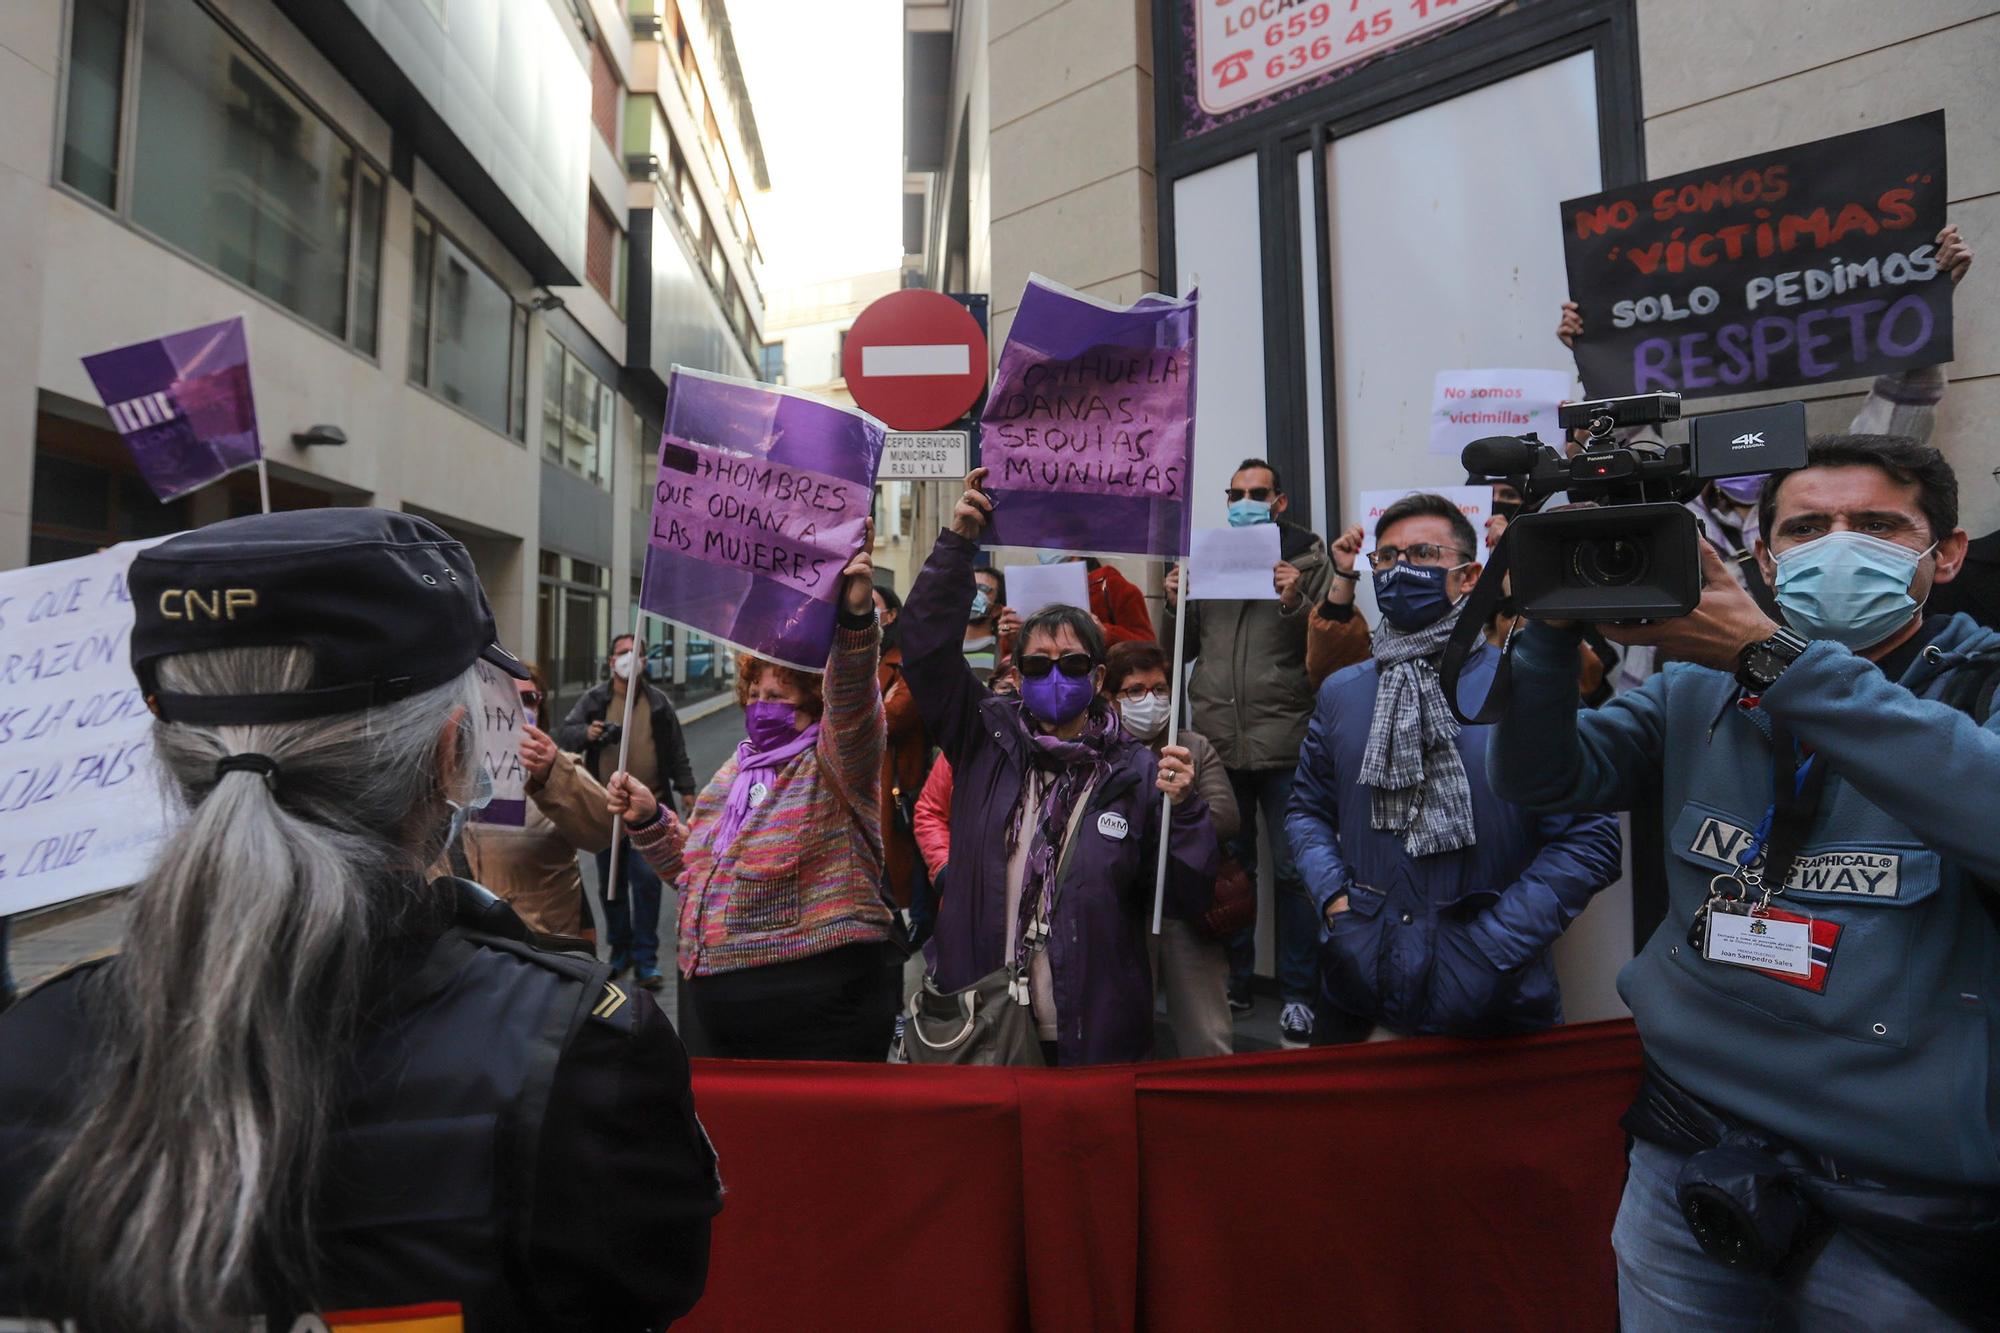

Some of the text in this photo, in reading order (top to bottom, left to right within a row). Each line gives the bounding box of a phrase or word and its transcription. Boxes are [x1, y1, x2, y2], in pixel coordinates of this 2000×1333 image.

[1225, 0, 1305, 37] LOCA
[1265, 3, 1330, 46] 659
[1265, 36, 1332, 79] 636
[1346, 9, 1393, 44] 45
[1576, 165, 1790, 239] NO SOMOS
[1612, 244, 1939, 328] SOLO PEDIMOS
[1633, 294, 1935, 393] RESPETO
[1444, 388, 1523, 398] No somos
[884, 437, 961, 448] CEPTO SERVICIOS
[890, 451, 947, 461] MUNICIPALES
[1732, 432, 1764, 444] 4K
[716, 457, 847, 512] HOMBRES
[921, 463, 927, 473] Y
[1005, 457, 1178, 496] MUNILLAS
[657, 480, 693, 508] QUE
[798, 523, 817, 545] A
[654, 516, 826, 587] LAS MUJERES
[160, 589, 257, 620] CNP
[1100, 817, 1127, 831] MxM
[1738, 952, 1773, 964] Sampedro
[1774, 958, 1793, 967] Sales
